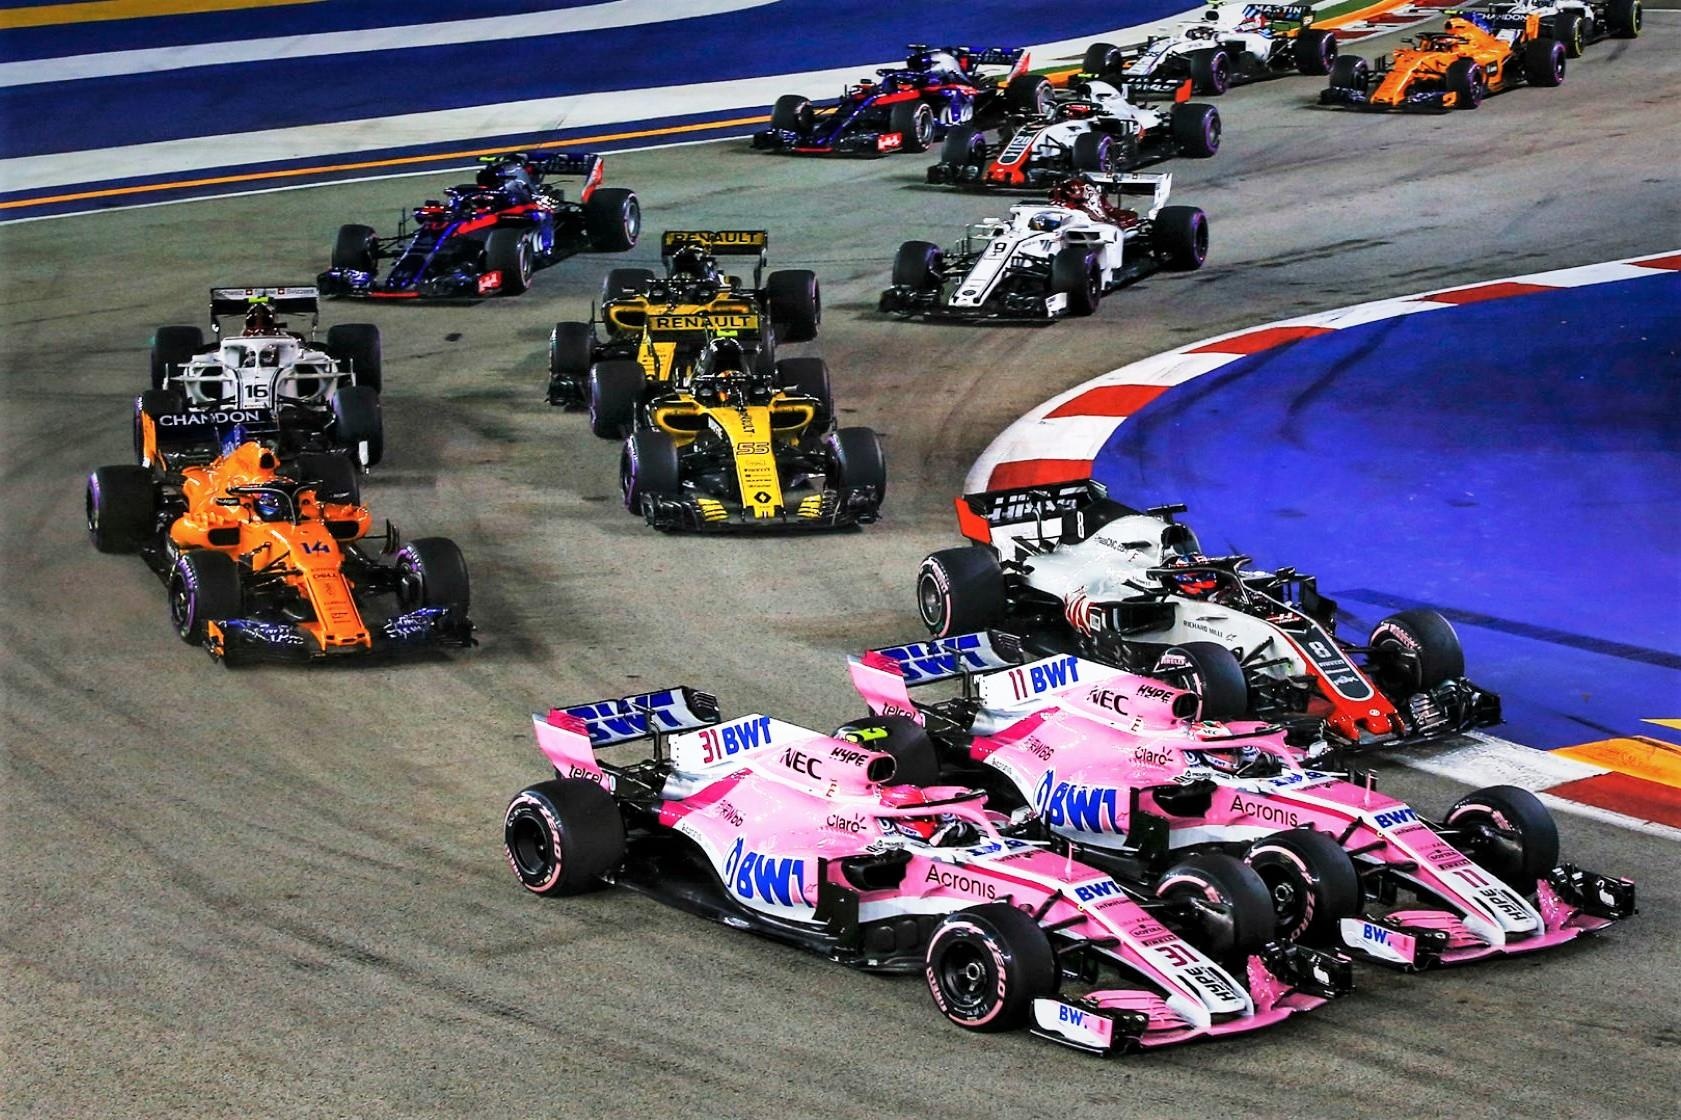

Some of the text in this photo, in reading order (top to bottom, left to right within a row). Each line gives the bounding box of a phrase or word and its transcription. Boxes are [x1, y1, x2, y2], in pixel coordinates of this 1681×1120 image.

[656, 316, 751, 328] RENAULT
[244, 384, 268, 398] 16
[736, 442, 770, 455] 55
[1076, 511, 1085, 539] 8
[1308, 640, 1332, 658] 8
[1008, 656, 1079, 700] 11 BWT
[1086, 685, 1129, 716] NEC
[1136, 684, 1175, 703] HYPE
[698, 716, 772, 764] 31 BWT
[780, 747, 822, 780] NEC
[831, 747, 869, 767] HYPE
[1134, 746, 1168, 765] Claro
[1230, 795, 1299, 827] Acronis
[826, 814, 861, 833] Claro
[926, 865, 997, 900] Acronis
[1452, 868, 1490, 888] 11
[1155, 943, 1200, 967] 31
[1185, 966, 1236, 1002] HYPE
